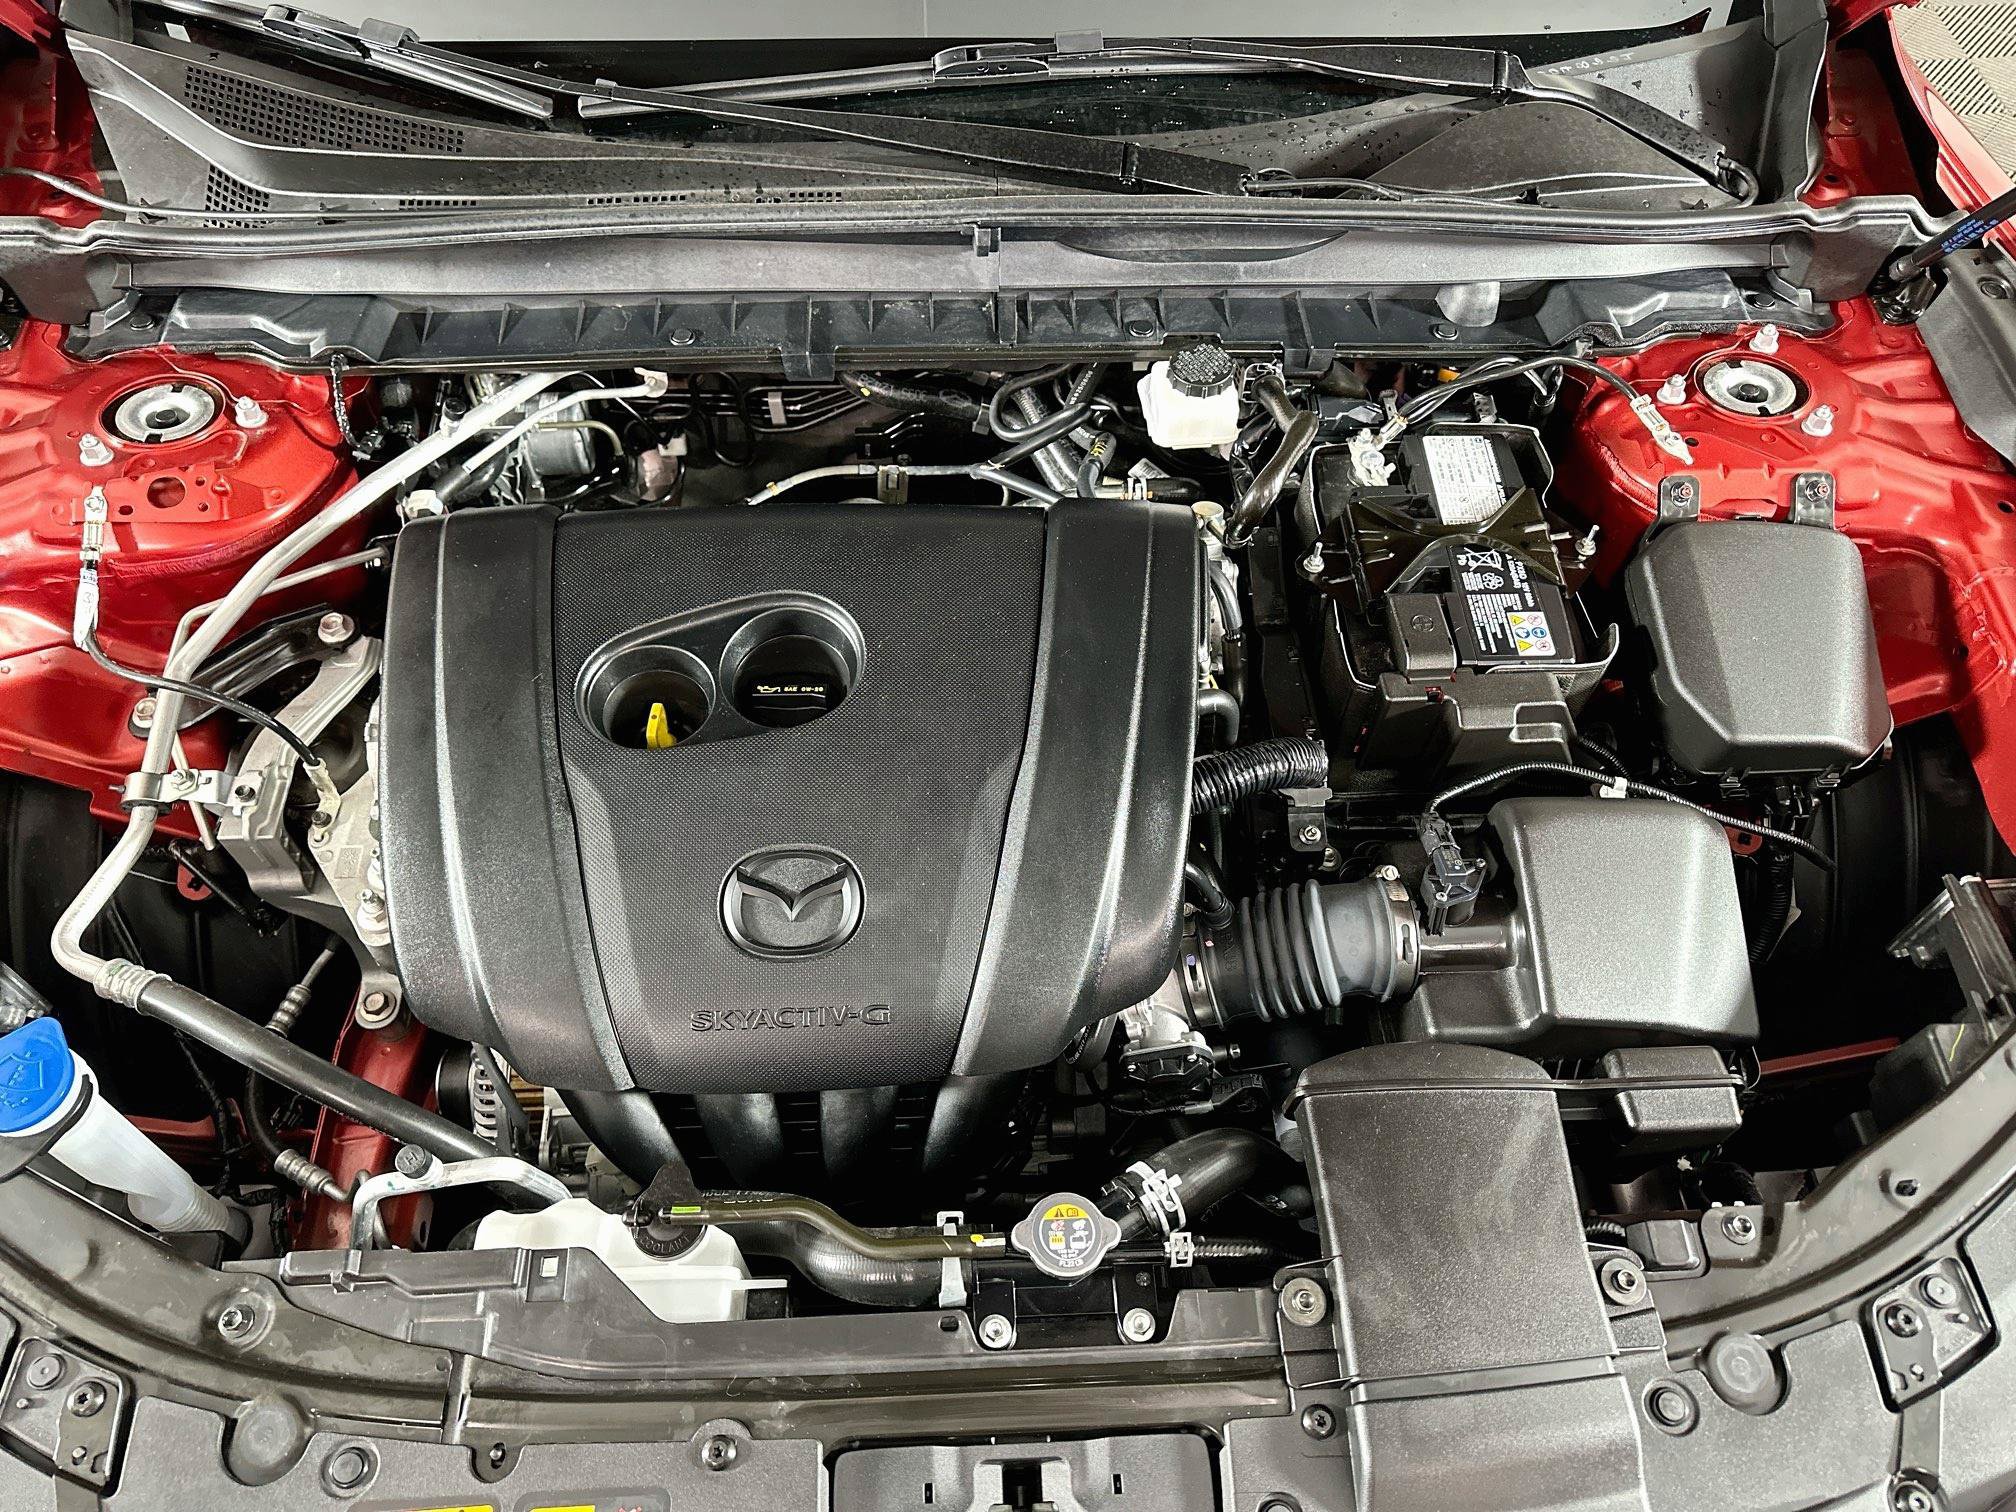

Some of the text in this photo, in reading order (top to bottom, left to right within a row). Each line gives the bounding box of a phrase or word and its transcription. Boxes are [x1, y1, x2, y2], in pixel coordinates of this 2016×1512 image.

[1943, 218, 1999, 254] STABILUS
[690, 1004, 890, 1031] SKYACTIV-G
[639, 1233, 691, 1254] COOLANT
